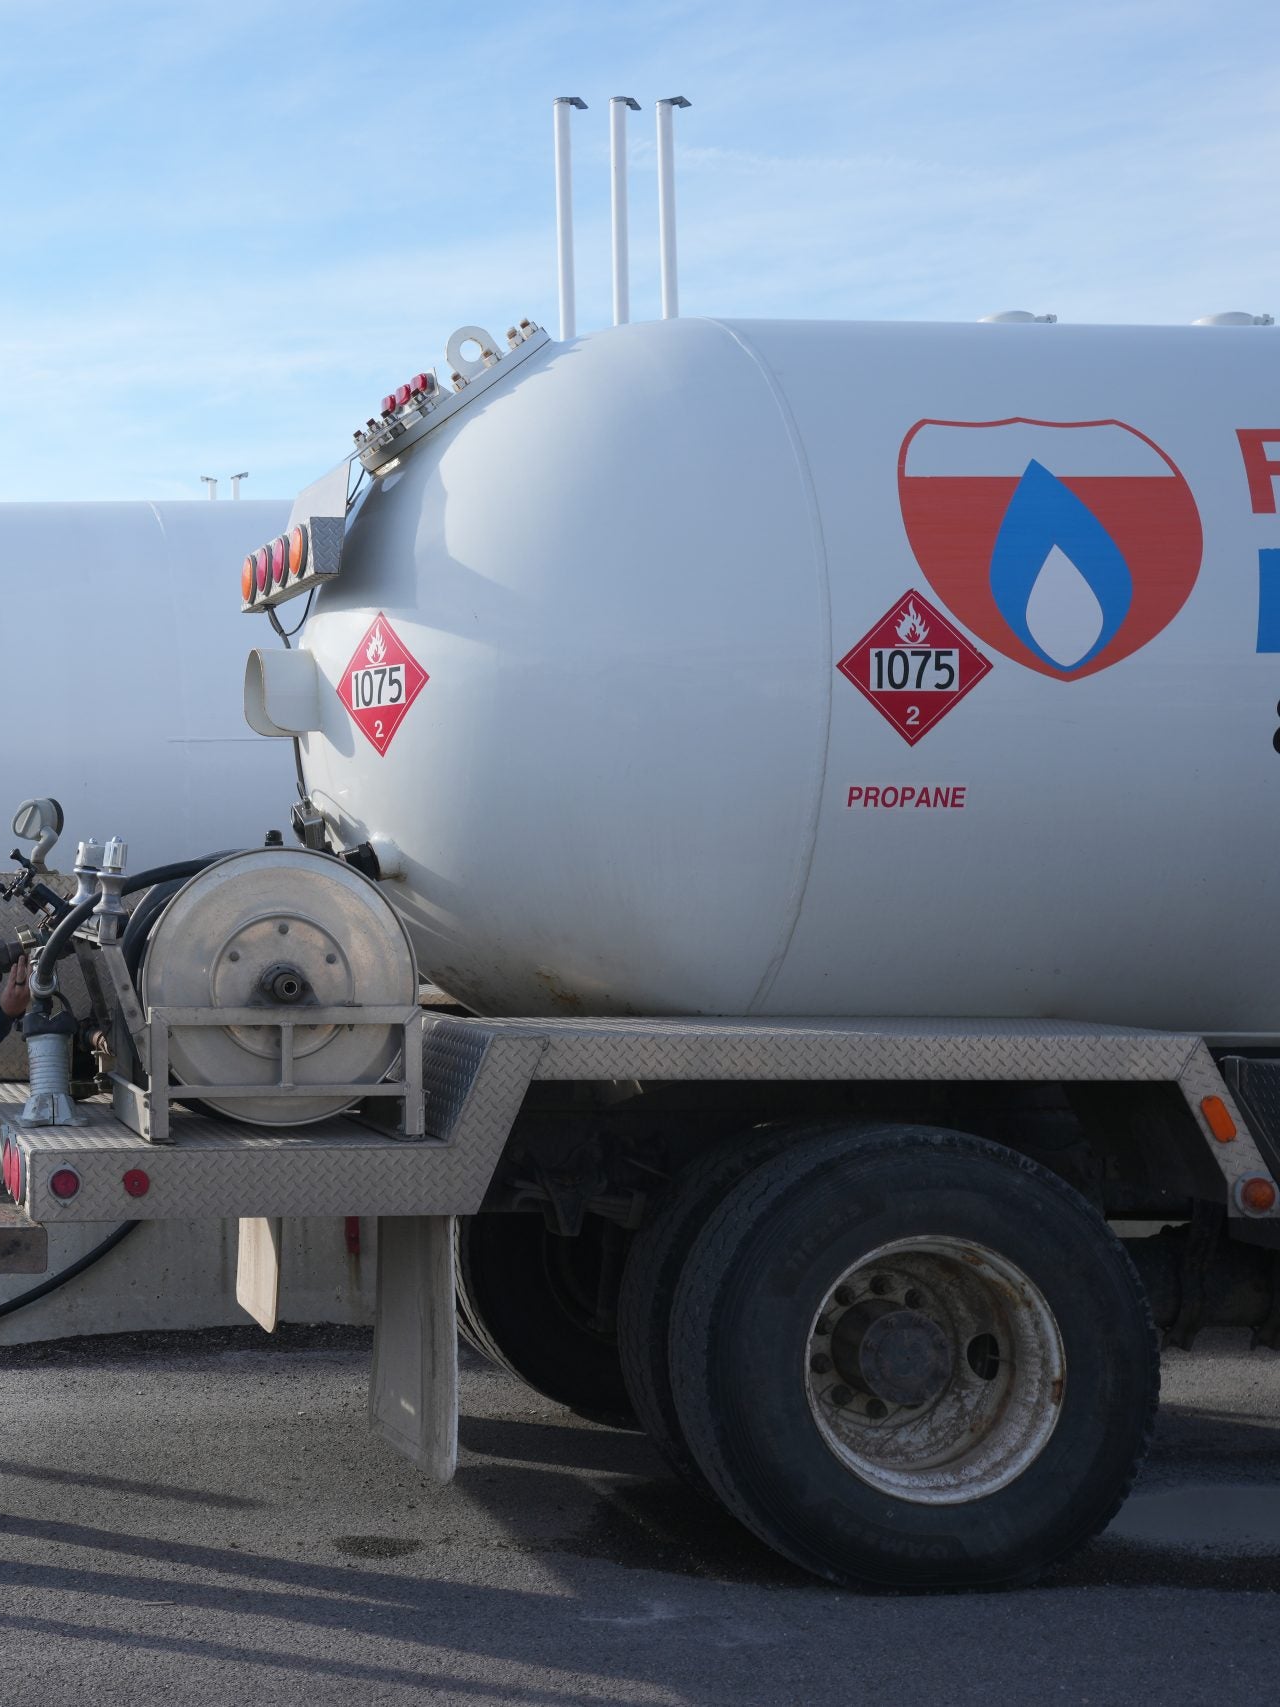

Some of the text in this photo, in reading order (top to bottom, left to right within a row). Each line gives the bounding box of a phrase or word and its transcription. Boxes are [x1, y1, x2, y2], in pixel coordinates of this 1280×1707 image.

[874, 650, 955, 689] 1075
[354, 666, 402, 708] 1075
[905, 706, 920, 725] 2
[374, 720, 384, 738] 2
[847, 786, 967, 808] PROPANE
